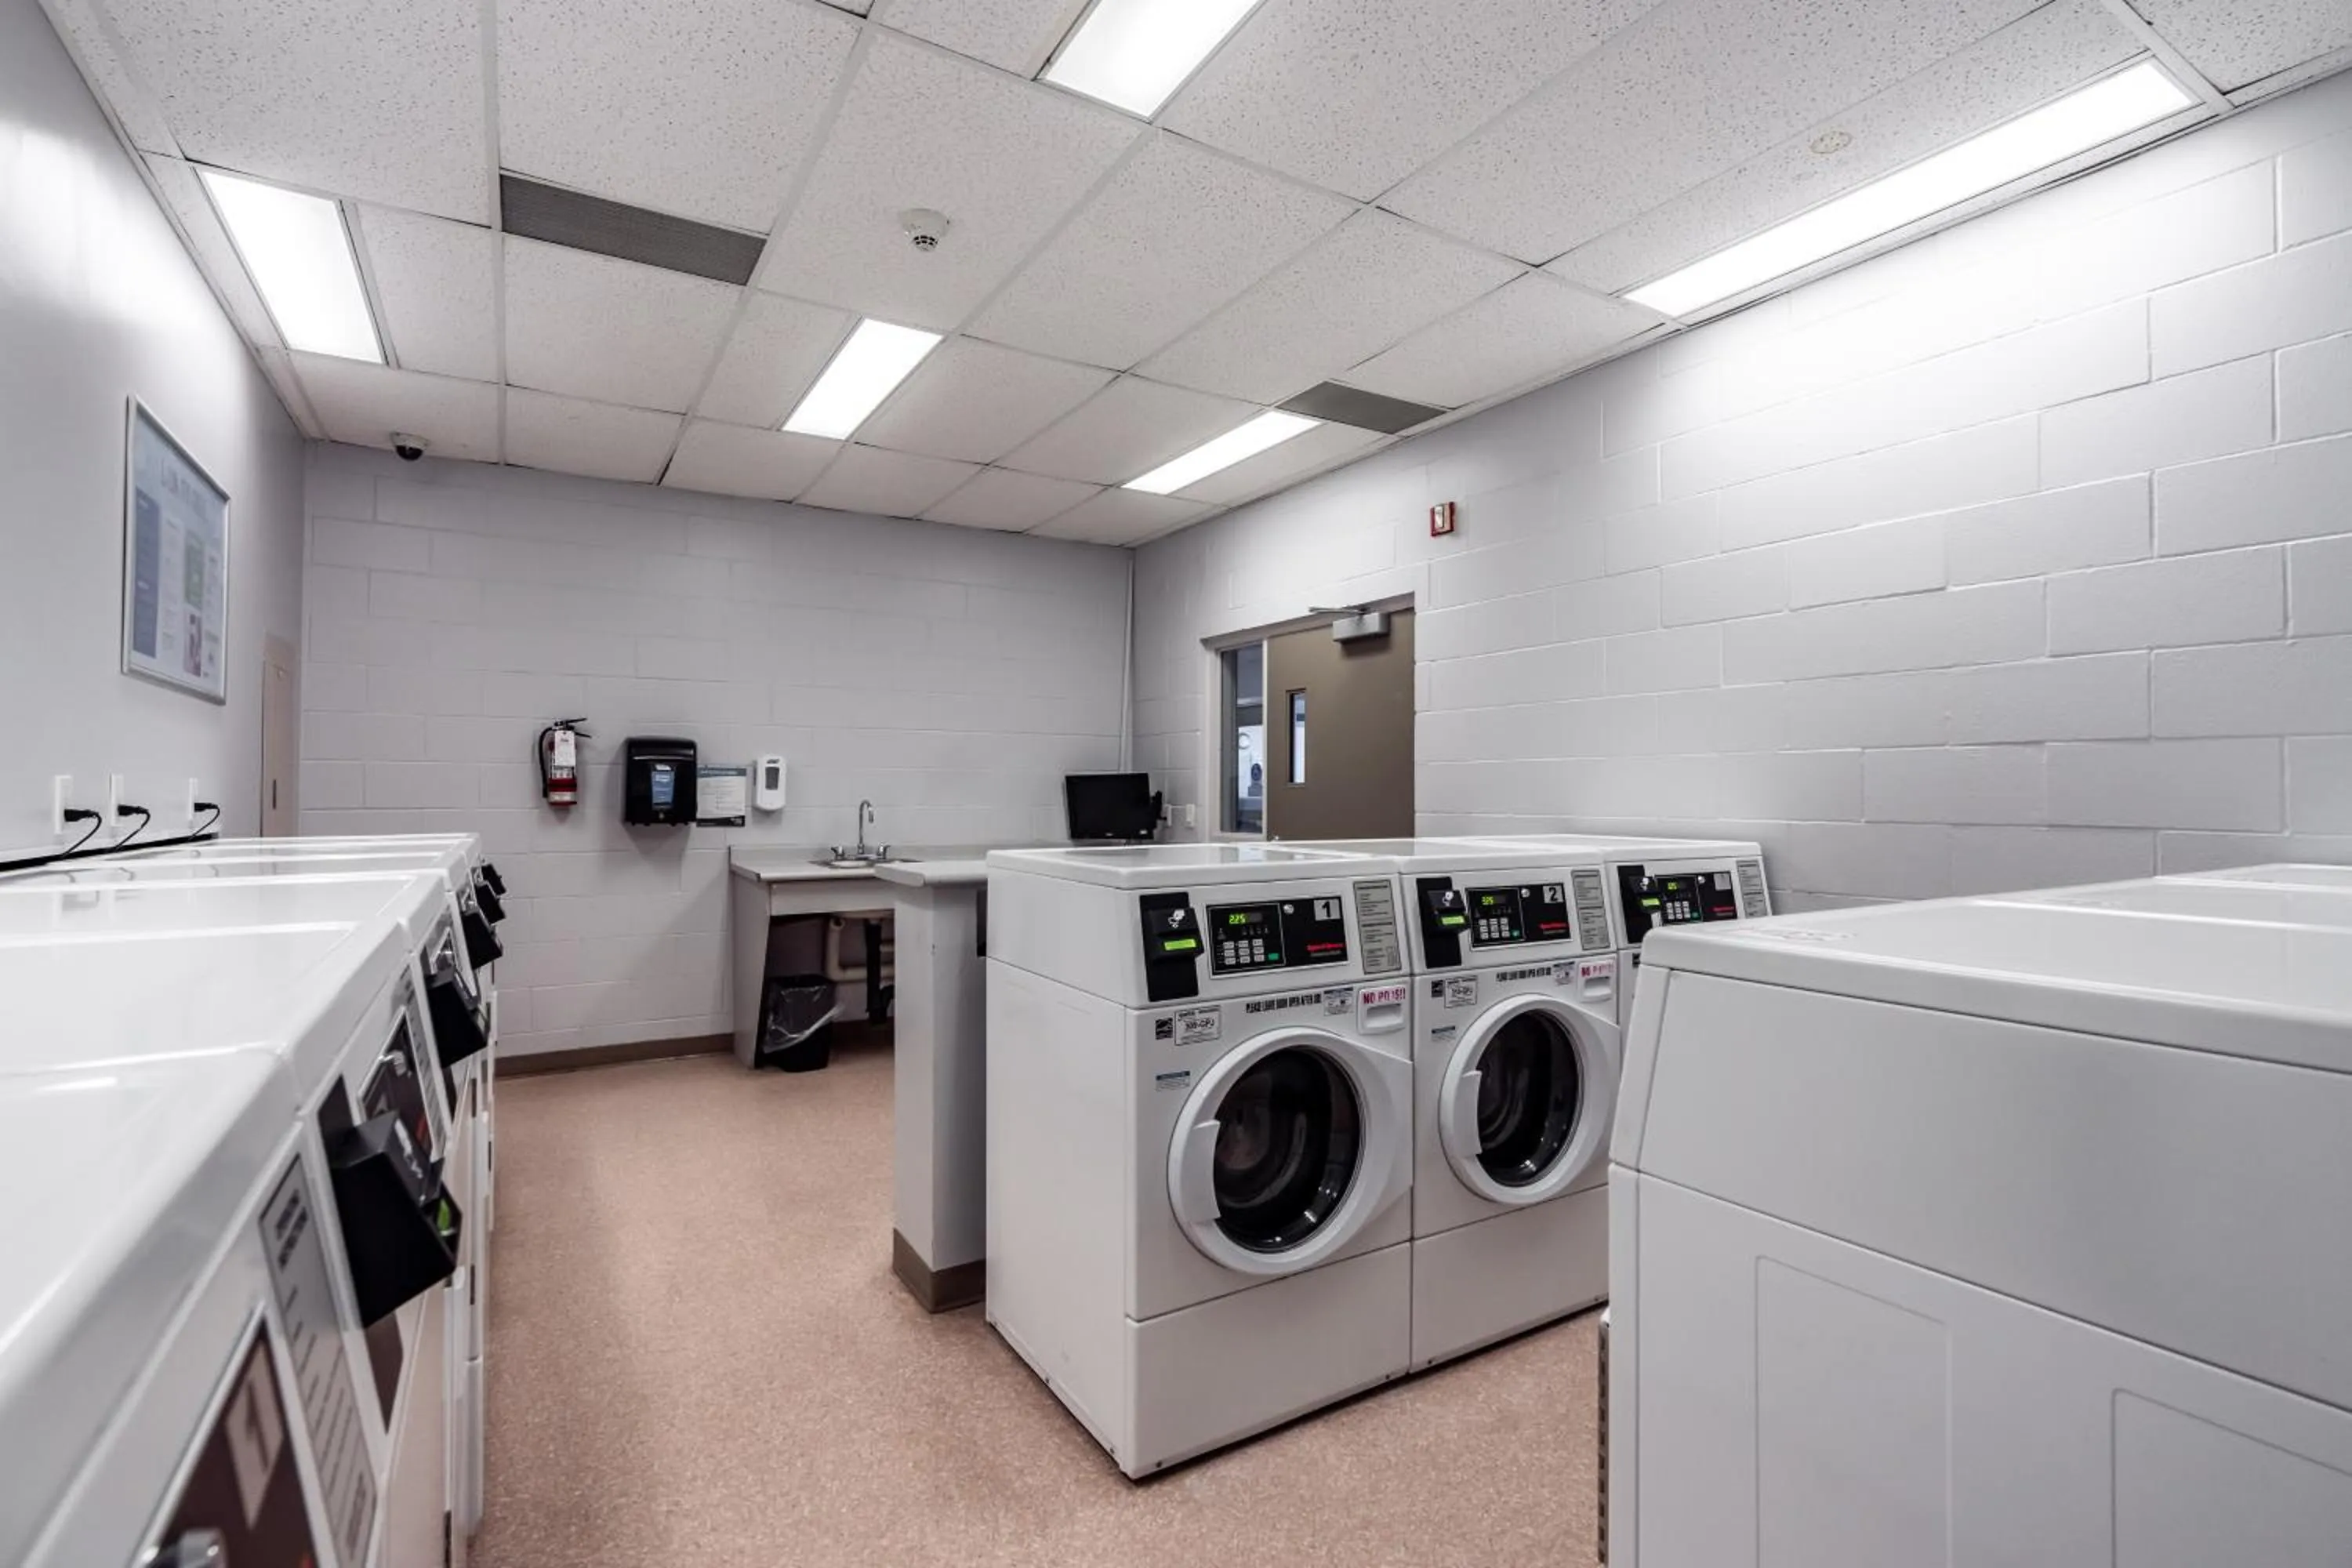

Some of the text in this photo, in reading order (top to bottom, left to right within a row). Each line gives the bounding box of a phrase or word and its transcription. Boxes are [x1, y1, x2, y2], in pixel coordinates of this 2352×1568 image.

[1548, 887, 1559, 902] 2
[1321, 901, 1331, 918] 1
[1229, 913, 1246, 924] 225
[1363, 992, 1375, 1004] NO
